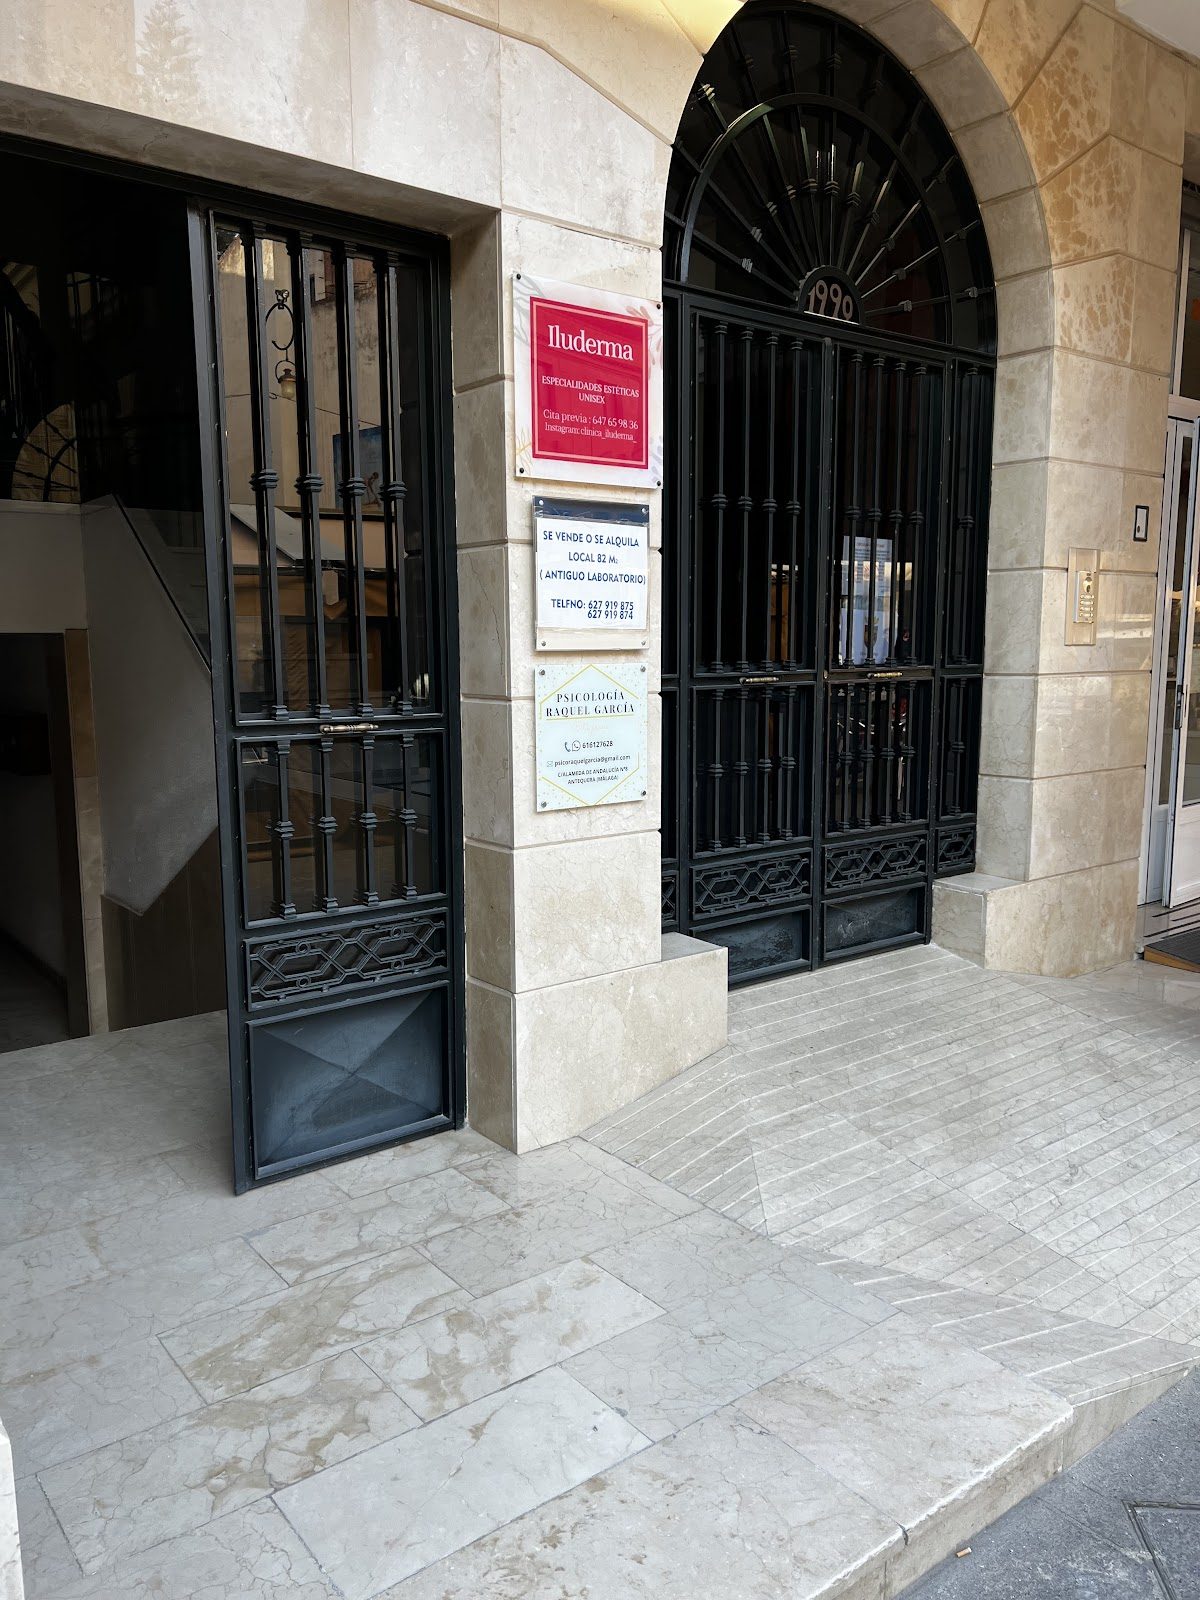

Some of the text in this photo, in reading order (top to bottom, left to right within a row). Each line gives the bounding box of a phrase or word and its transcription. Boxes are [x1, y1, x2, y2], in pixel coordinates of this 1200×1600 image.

[808, 279, 853, 320] 1990
[548, 325, 634, 360] Iluderma
[542, 375, 602, 393] ESPECIALIDADES
[579, 393, 605, 404] UNISEX
[543, 409, 560, 419] Cita
[561, 412, 587, 424] previa
[593, 416, 606, 425] 647
[608, 417, 617, 427] 65
[619, 419, 628, 429] 98
[629, 420, 638, 430] 36
[545, 422, 580, 435] Instagram:
[543, 530, 640, 548] SE VENDE O SE ALQUILA
[568, 551, 595, 563] LOCAL
[597, 553, 606, 563] 82
[545, 570, 585, 581] ANTIGUO
[587, 571, 646, 585] LABORATORIO)
[551, 598, 634, 611] TELFNO: 627 919 875
[587, 609, 633, 620] 627 919 874
[556, 689, 624, 703] PSICOLOGÍA
[546, 701, 634, 718] RAQUEL GARCÍA
